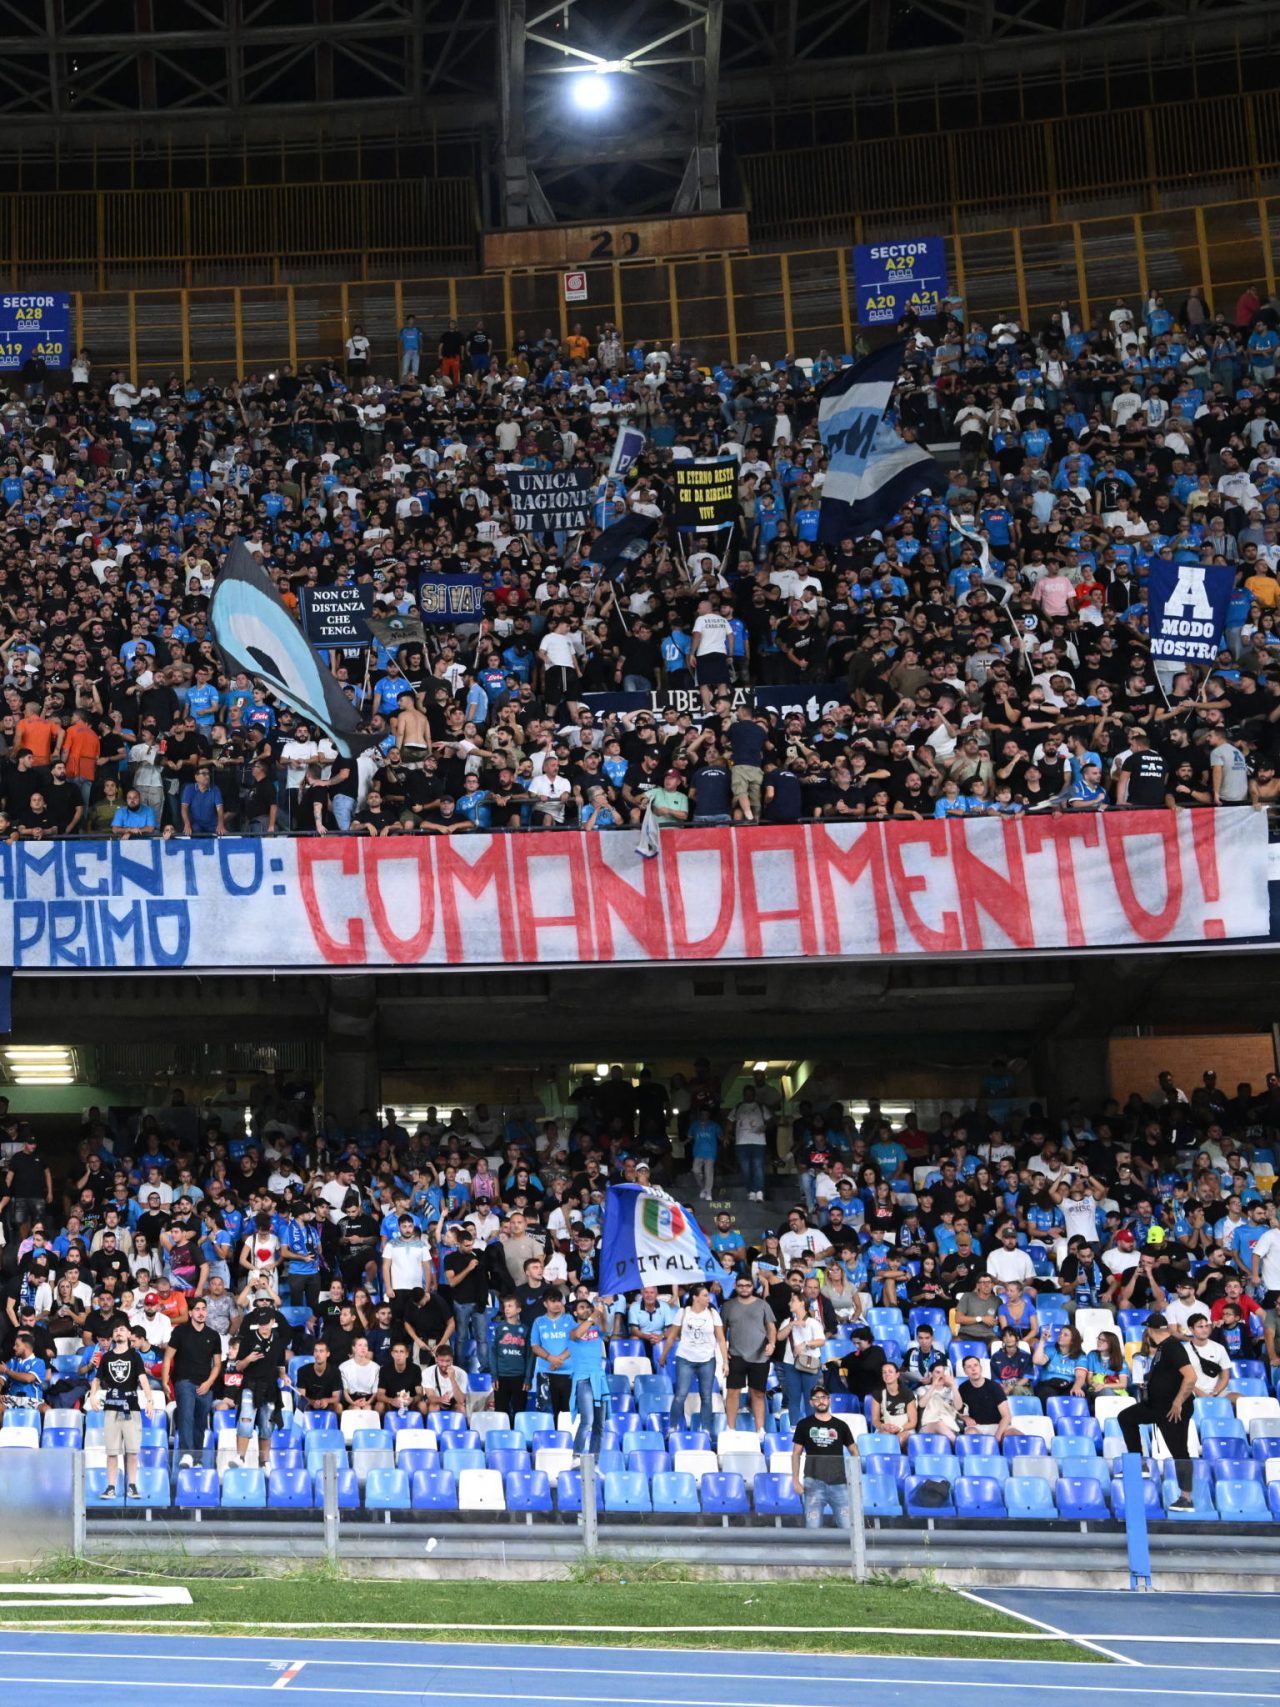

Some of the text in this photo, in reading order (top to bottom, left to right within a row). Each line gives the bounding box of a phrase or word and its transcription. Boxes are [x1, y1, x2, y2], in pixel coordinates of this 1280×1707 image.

[590, 230, 641, 258] 20
[870, 242, 927, 259] SECTOR
[885, 256, 915, 271] A29
[2, 296, 55, 309] SECTOR
[865, 290, 939, 311] A20 A21
[15, 307, 43, 321] A28
[36, 342, 63, 355] A20
[518, 471, 579, 492] UNICA
[676, 467, 735, 485] IN ETERNO RESTA
[510, 489, 589, 512] RAGION
[679, 485, 733, 503] CHI DA RIBELLE
[698, 505, 715, 520] VIVE
[513, 513, 534, 531] DI
[313, 590, 340, 601] NON
[1163, 565, 1214, 620] A
[311, 601, 366, 614] DISTANZA
[326, 614, 351, 625] CHE
[1160, 618, 1215, 639] MODO
[319, 625, 358, 636] TENGA
[665, 643, 680, 662] 10
[1149, 637, 1218, 661] NOSTRO
[1148, 762, 1157, 771] A
[295, 806, 1227, 965] COMANDAMENTO!
[13, 899, 191, 967] PRIMO
[616, 1253, 716, 1278] D'ITALIA
